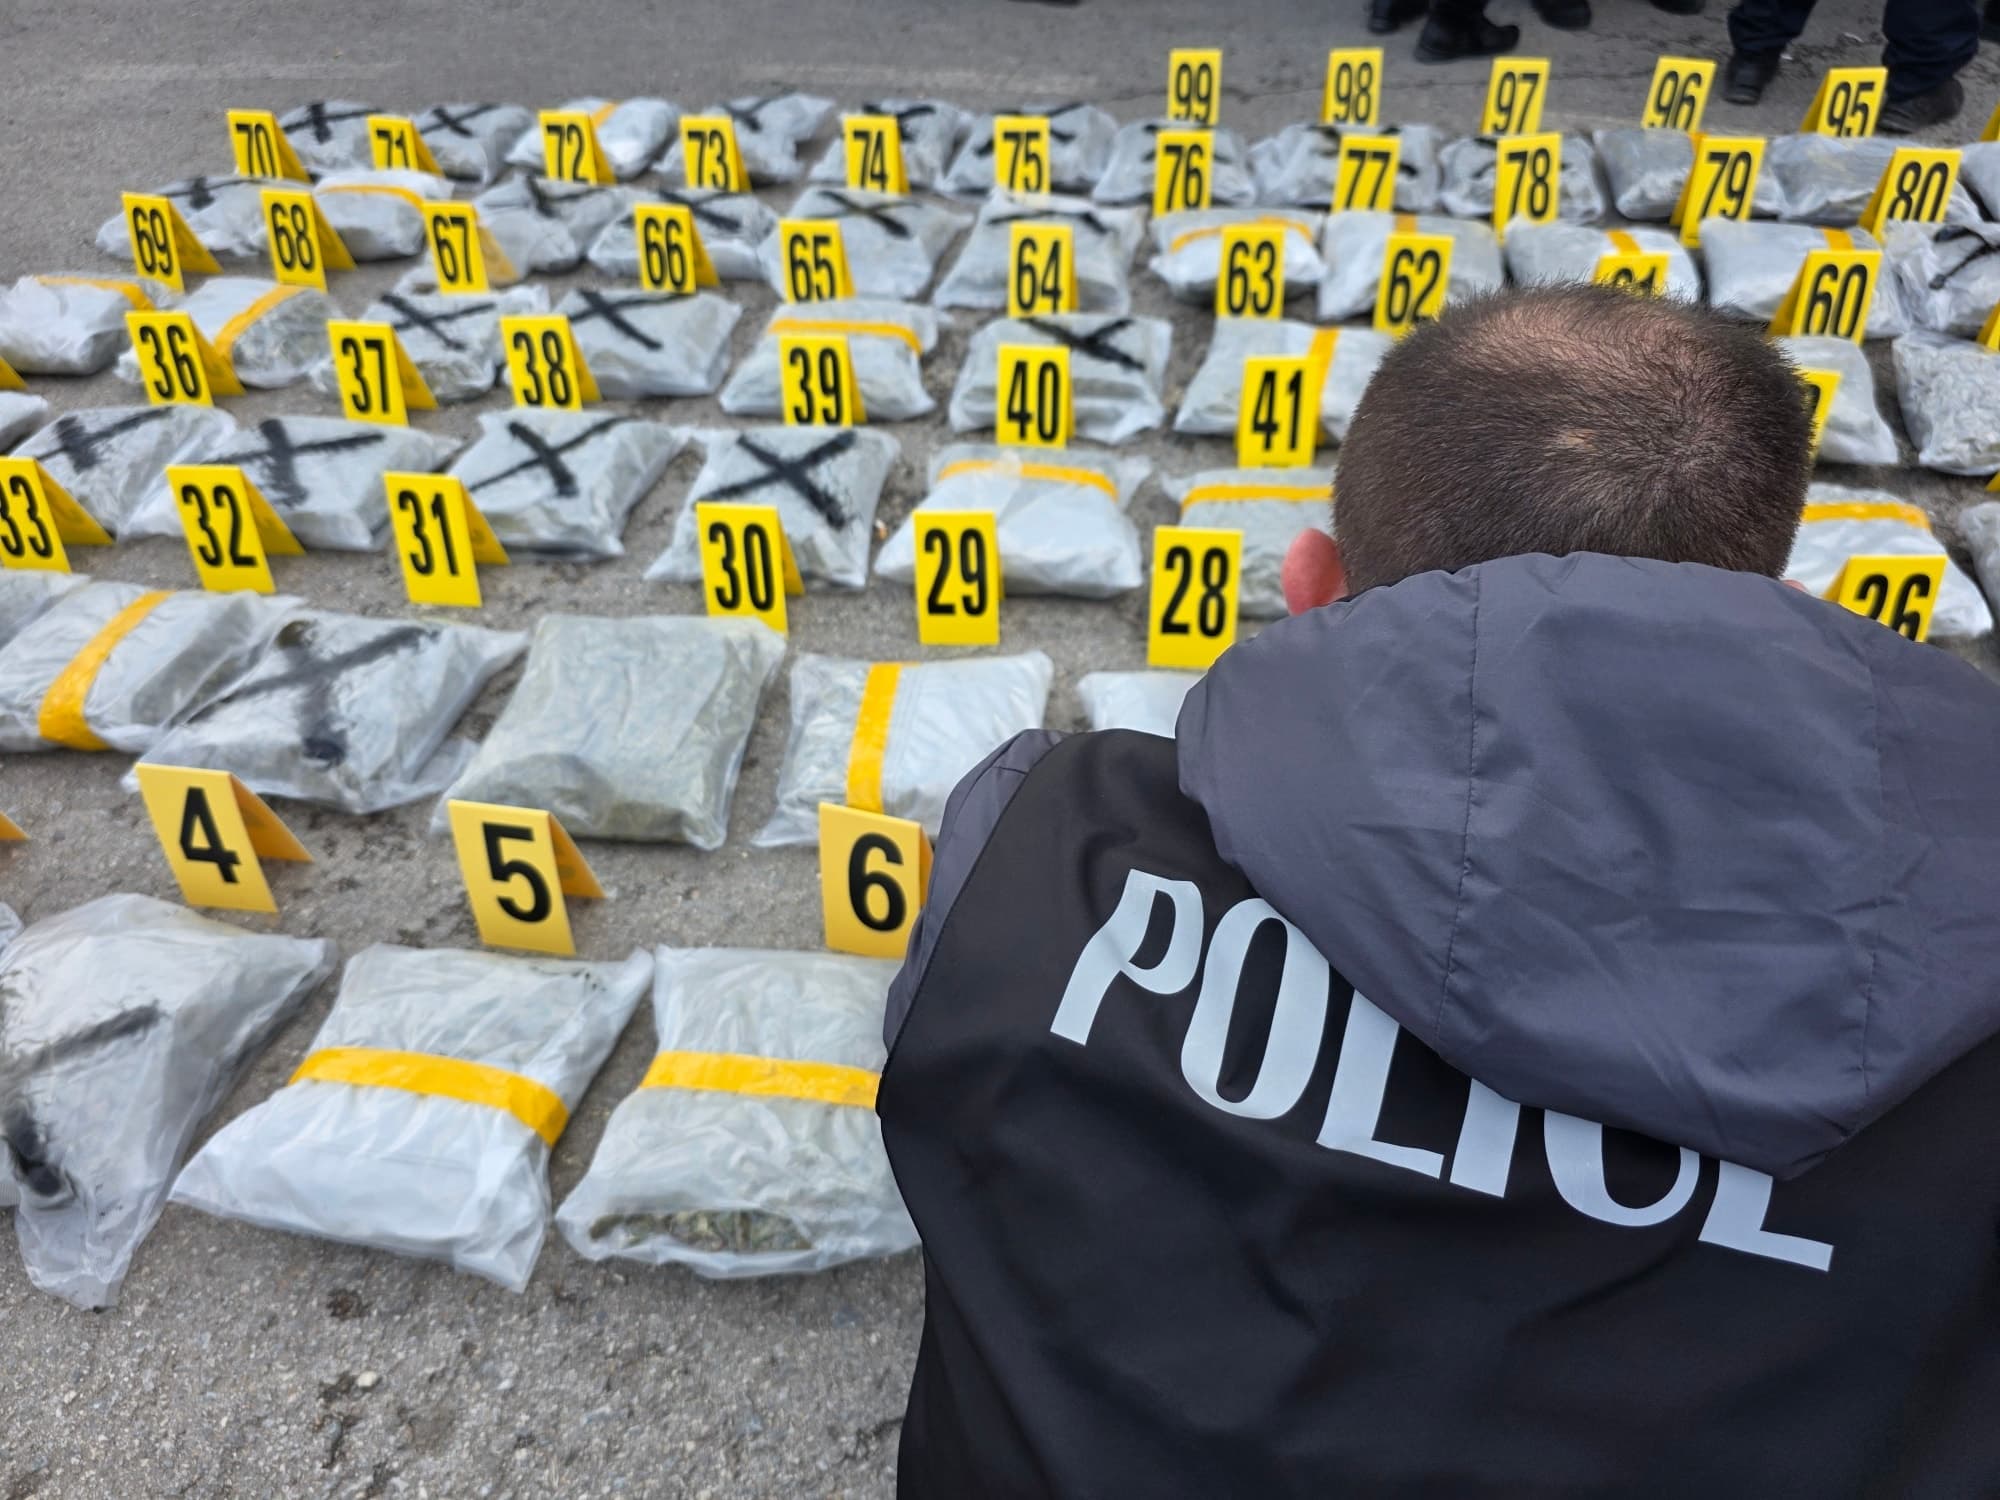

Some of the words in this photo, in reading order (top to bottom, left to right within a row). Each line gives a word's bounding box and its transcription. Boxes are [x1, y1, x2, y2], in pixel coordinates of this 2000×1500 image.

[1176, 63, 1212, 121] 99
[1336, 62, 1372, 122] 98
[1493, 71, 1540, 134] 97
[1655, 70, 1702, 130] 96
[1827, 81, 1875, 134] 95
[235, 123, 276, 176] 70
[376, 129, 408, 167] 71
[546, 123, 587, 181] 72
[687, 129, 729, 189] 73
[853, 130, 887, 190] 74
[1003, 131, 1042, 190] 75
[1164, 143, 1204, 210] 76
[1345, 149, 1391, 209] 77
[1507, 148, 1551, 219] 78
[1700, 151, 1752, 221] 79
[1887, 161, 1949, 222] 80
[132, 206, 173, 276] 69
[271, 202, 314, 271] 68
[432, 215, 471, 283] 67
[643, 217, 686, 291] 66
[789, 233, 835, 300] 65
[1016, 237, 1062, 312] 64
[1227, 240, 1276, 316] 63
[1386, 248, 1441, 327] 62
[1803, 263, 1868, 339] 60
[139, 324, 200, 400] 36
[341, 337, 389, 413] 37
[513, 330, 571, 407] 38
[789, 347, 843, 425] 39
[1007, 360, 1060, 442] 40
[1252, 370, 1302, 451] 41
[181, 484, 257, 567] 32
[398, 490, 458, 576] 31
[708, 522, 774, 612] 30
[924, 528, 987, 617] 29
[1160, 546, 1229, 638] 28
[179, 787, 240, 883] 4
[482, 822, 551, 924] 5
[848, 833, 906, 933] 6
